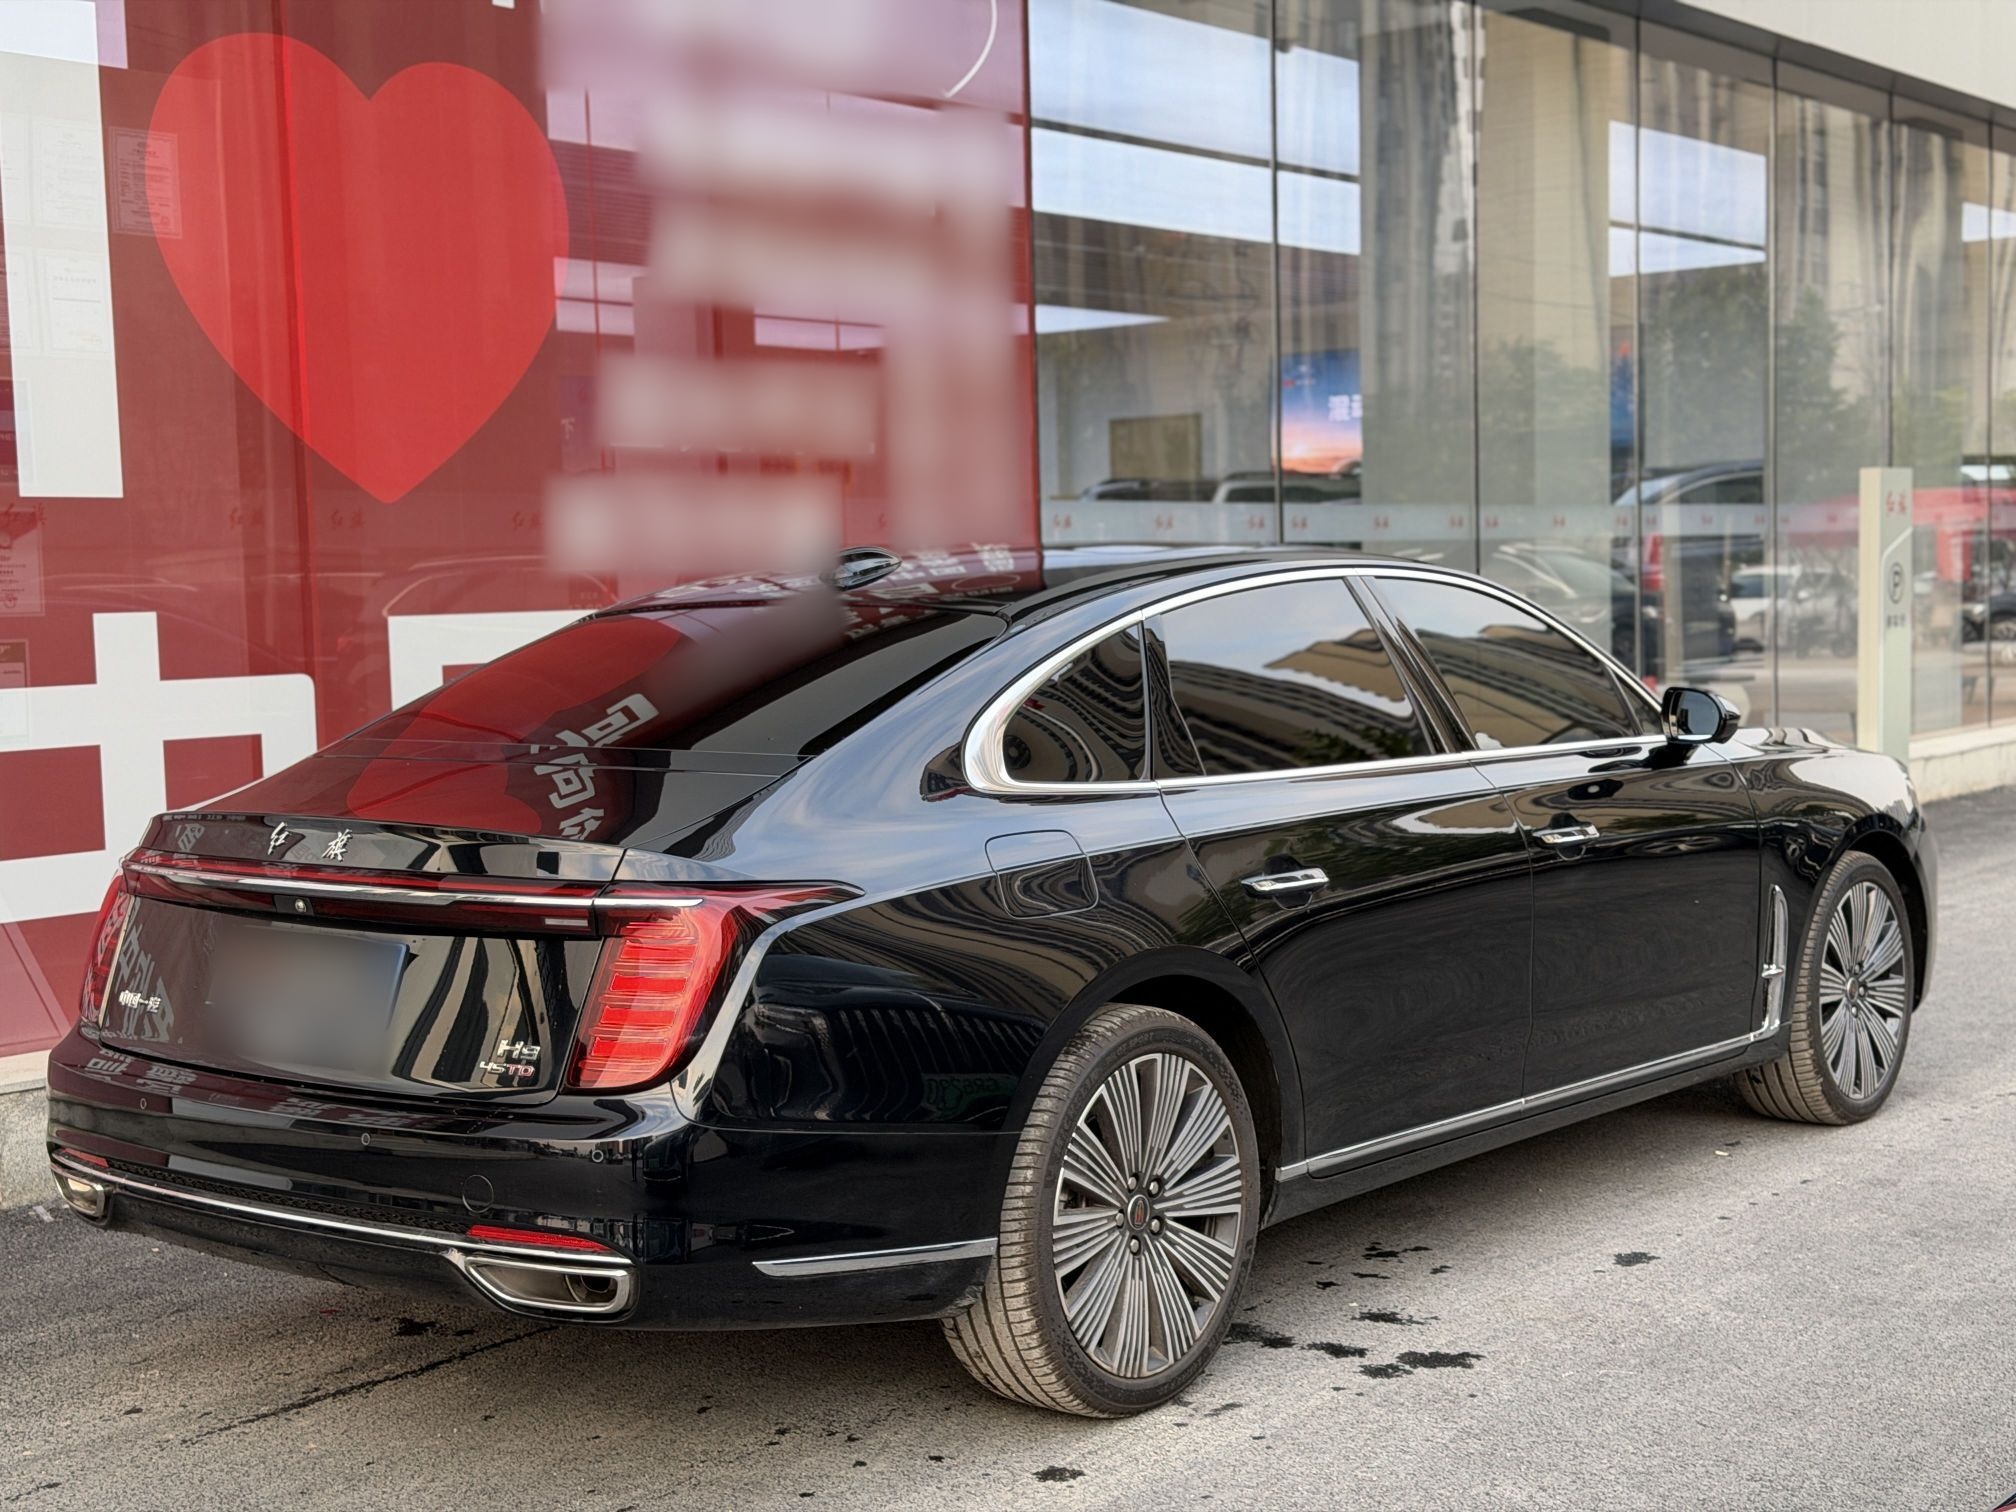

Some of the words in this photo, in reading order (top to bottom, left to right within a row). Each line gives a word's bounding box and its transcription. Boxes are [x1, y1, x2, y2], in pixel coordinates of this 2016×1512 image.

[267, 821, 354, 862] 红旗
[496, 1039, 541, 1061] H9
[479, 1060, 536, 1078] 45TD
